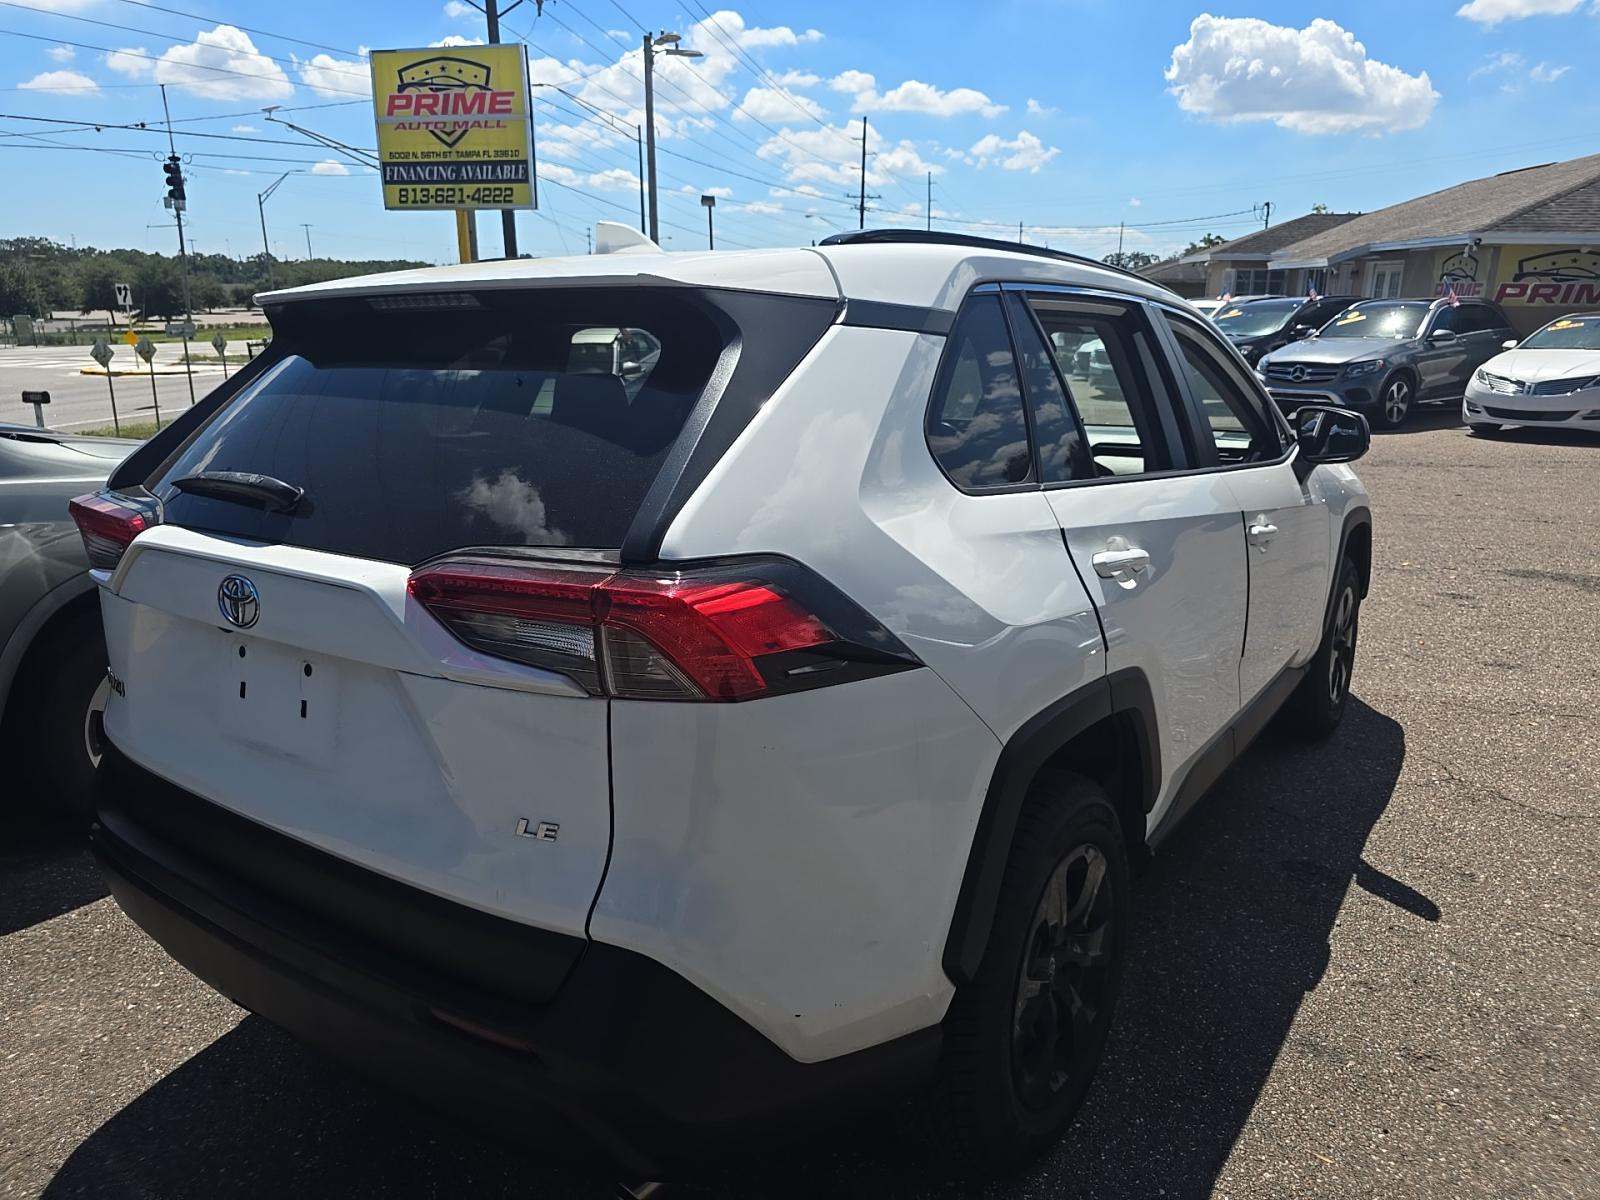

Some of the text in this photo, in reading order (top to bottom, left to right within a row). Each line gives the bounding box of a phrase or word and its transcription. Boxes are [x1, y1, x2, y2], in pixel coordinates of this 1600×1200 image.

[387, 91, 515, 117] PRIME
[394, 119, 507, 131] AUTO MALL
[456, 150, 481, 158] TAMPA
[482, 149, 492, 158] FL
[385, 163, 526, 181] FINANCING AVAILABLE
[515, 817, 560, 842] LE
